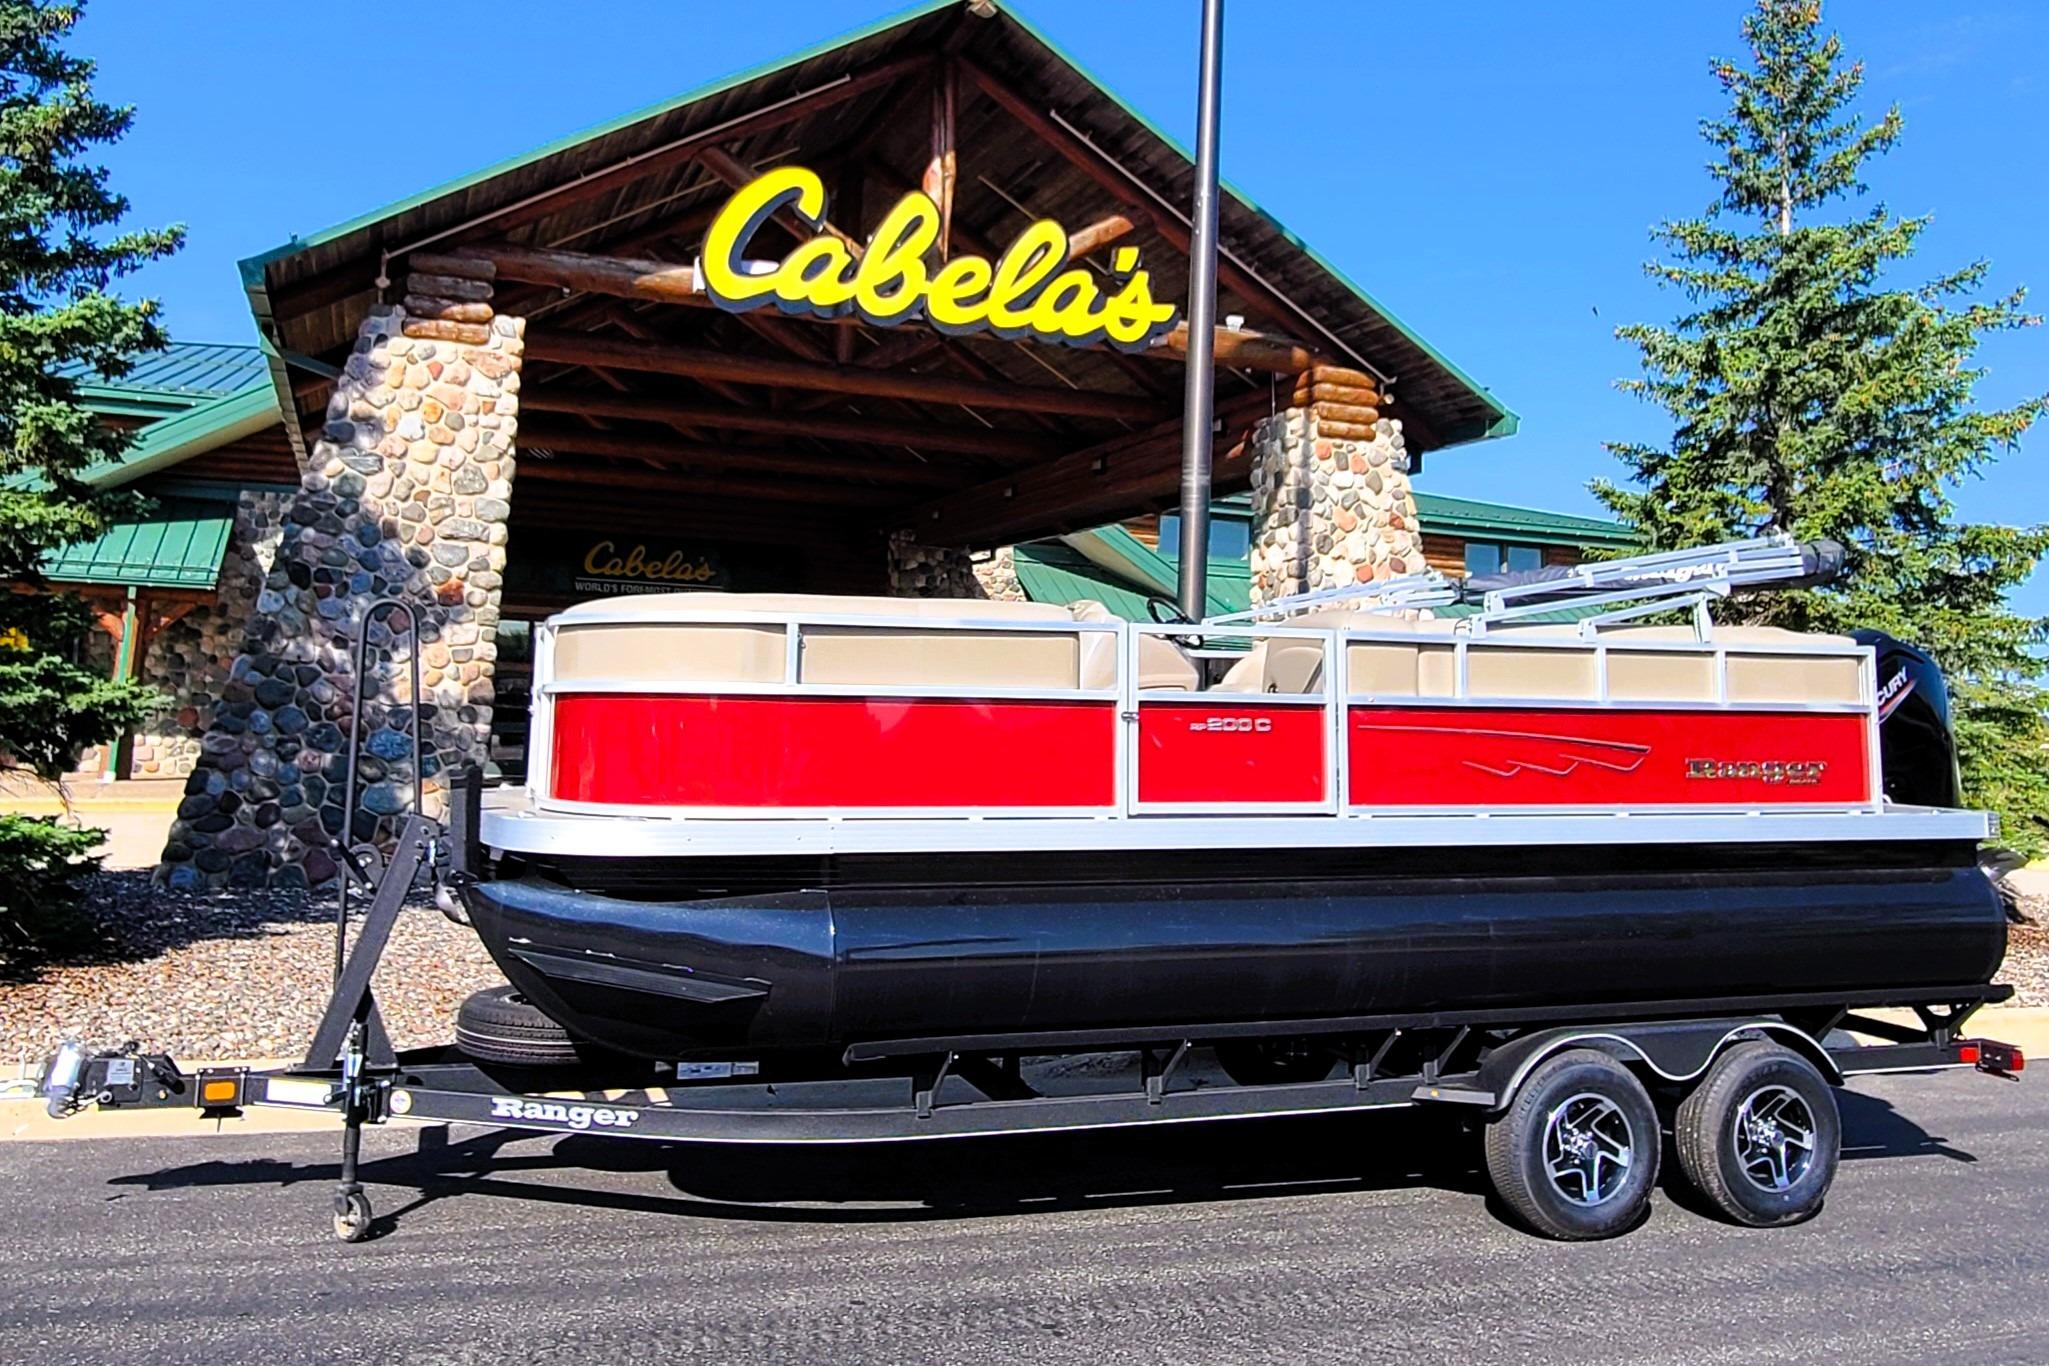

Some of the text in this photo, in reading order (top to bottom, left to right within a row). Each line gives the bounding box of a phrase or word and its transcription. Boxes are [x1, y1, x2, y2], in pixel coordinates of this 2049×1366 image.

[703, 165, 1177, 345] Cabela's
[583, 540, 717, 582] Cabela's
[574, 581, 619, 593] WORLD'S
[1685, 758, 1827, 784] Ranger
[491, 1097, 639, 1129] Ranger
